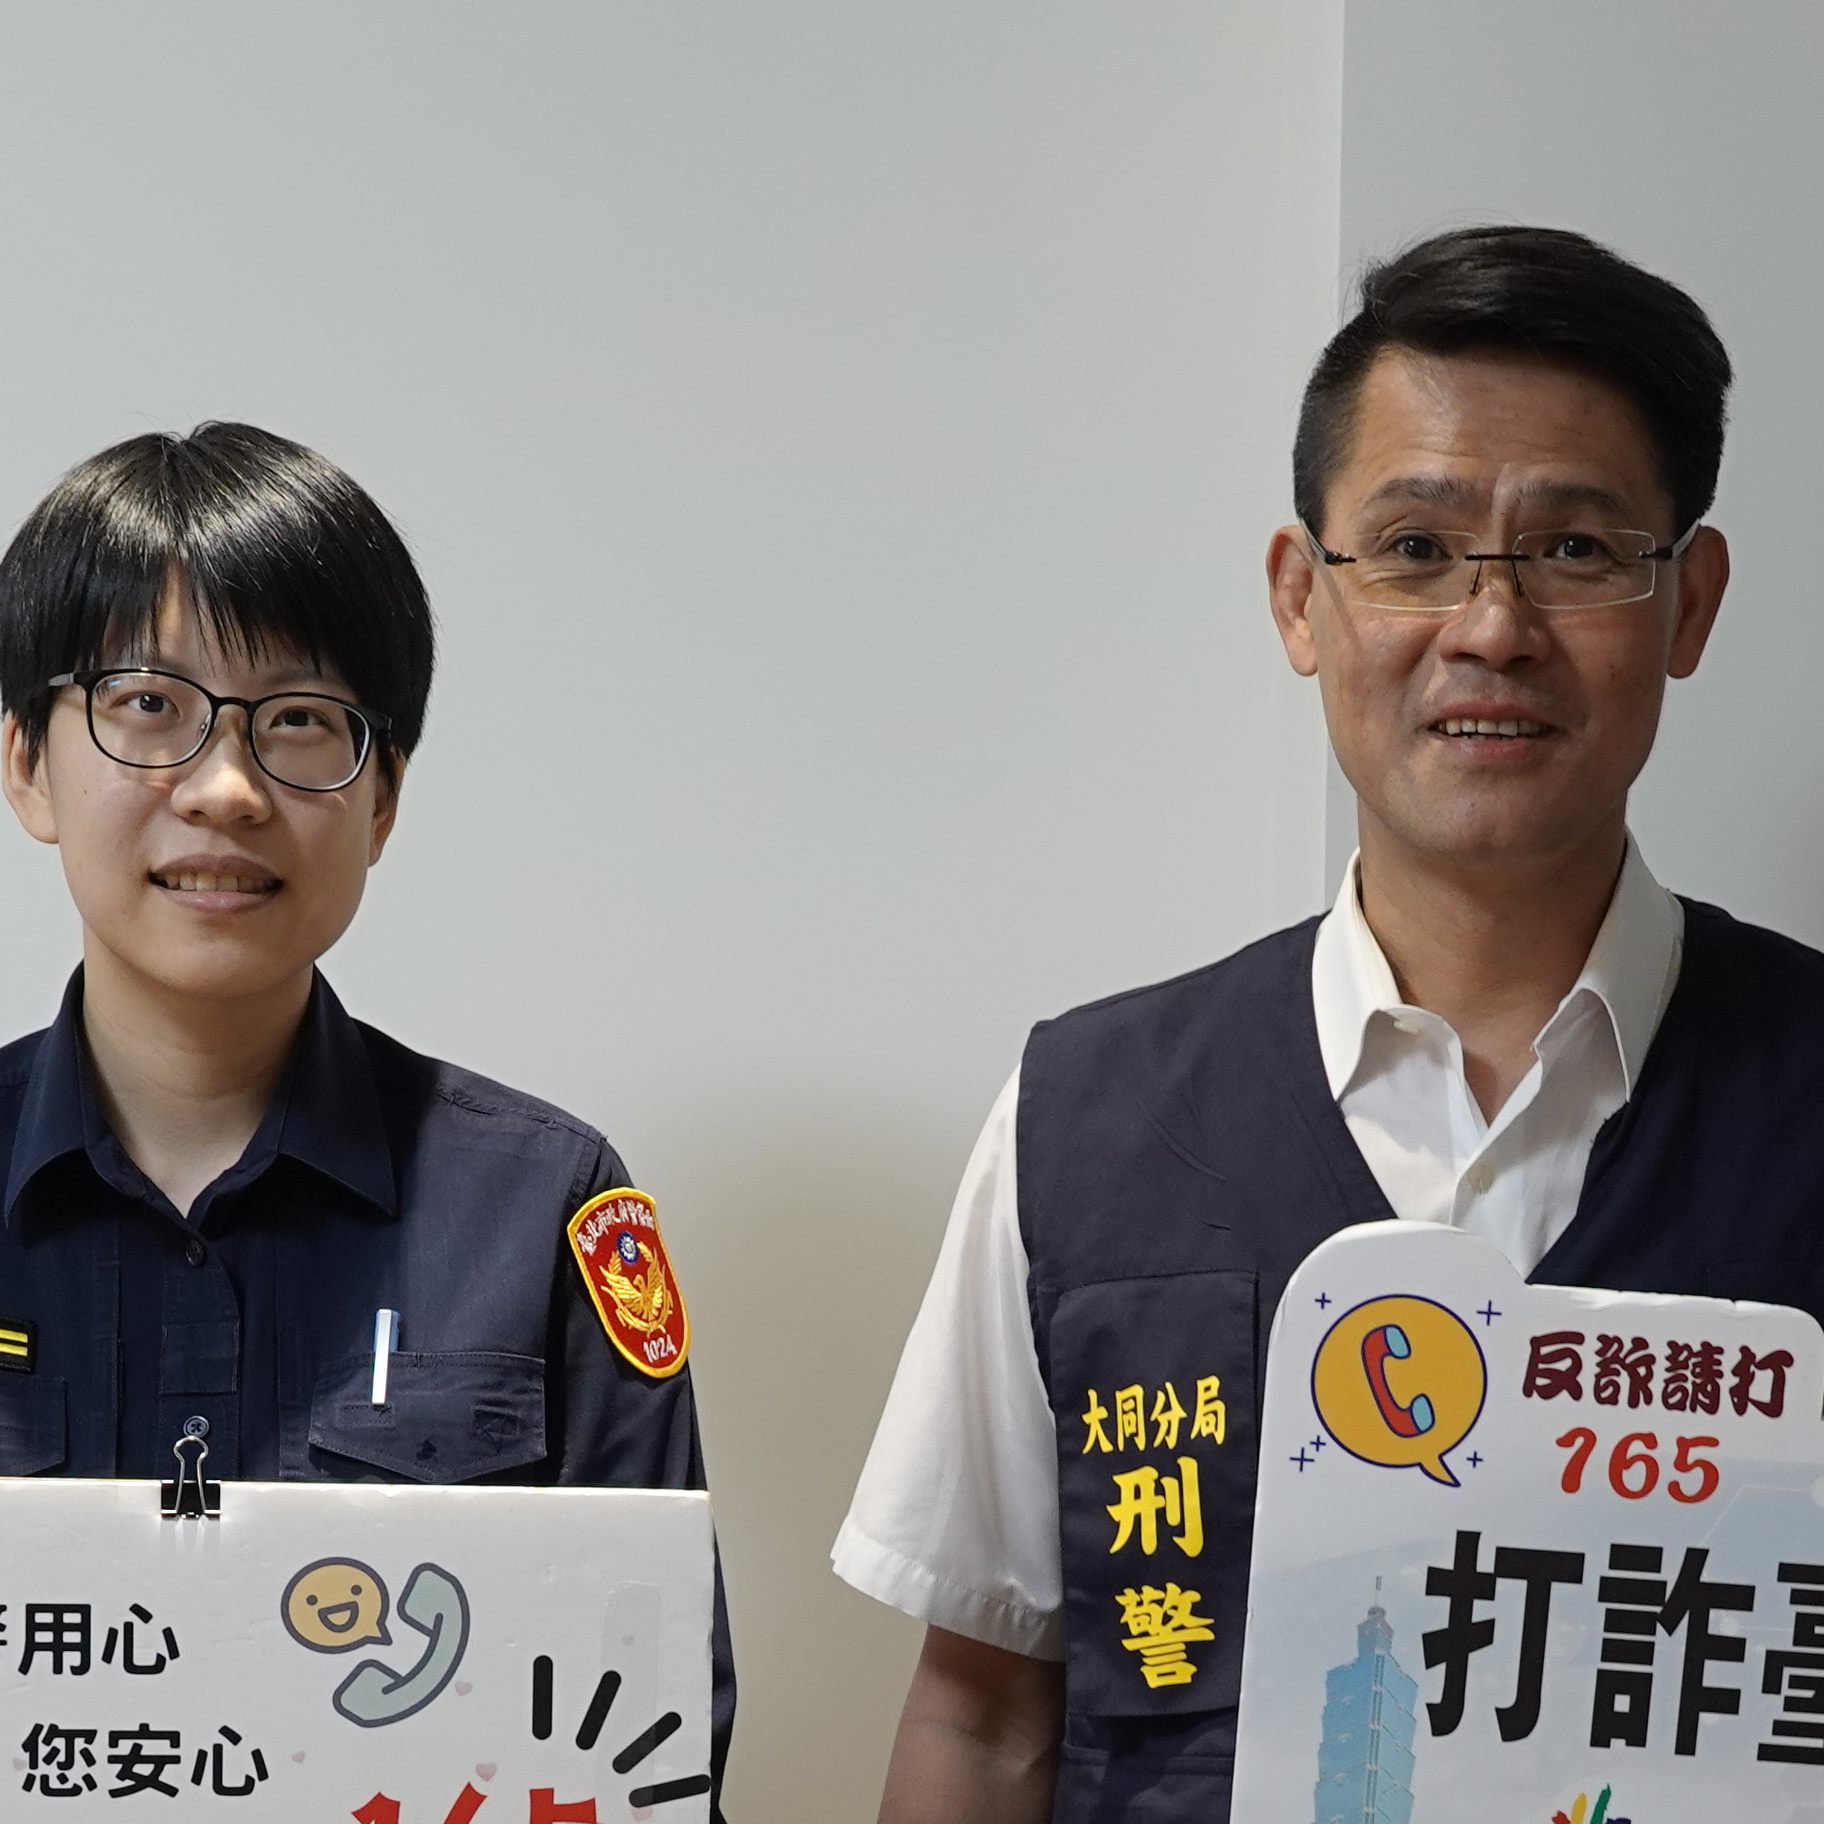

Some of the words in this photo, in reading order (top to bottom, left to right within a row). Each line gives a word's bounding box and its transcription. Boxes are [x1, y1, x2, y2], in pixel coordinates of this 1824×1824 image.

[643, 1334, 677, 1363] 1024
[1522, 1331, 1795, 1418] 反詐請打
[1081, 1375, 1226, 1455] 大同分局
[1554, 1427, 1720, 1504] 165
[1106, 1455, 1216, 1689] 刑警
[20, 1722, 269, 1799] 您安心
